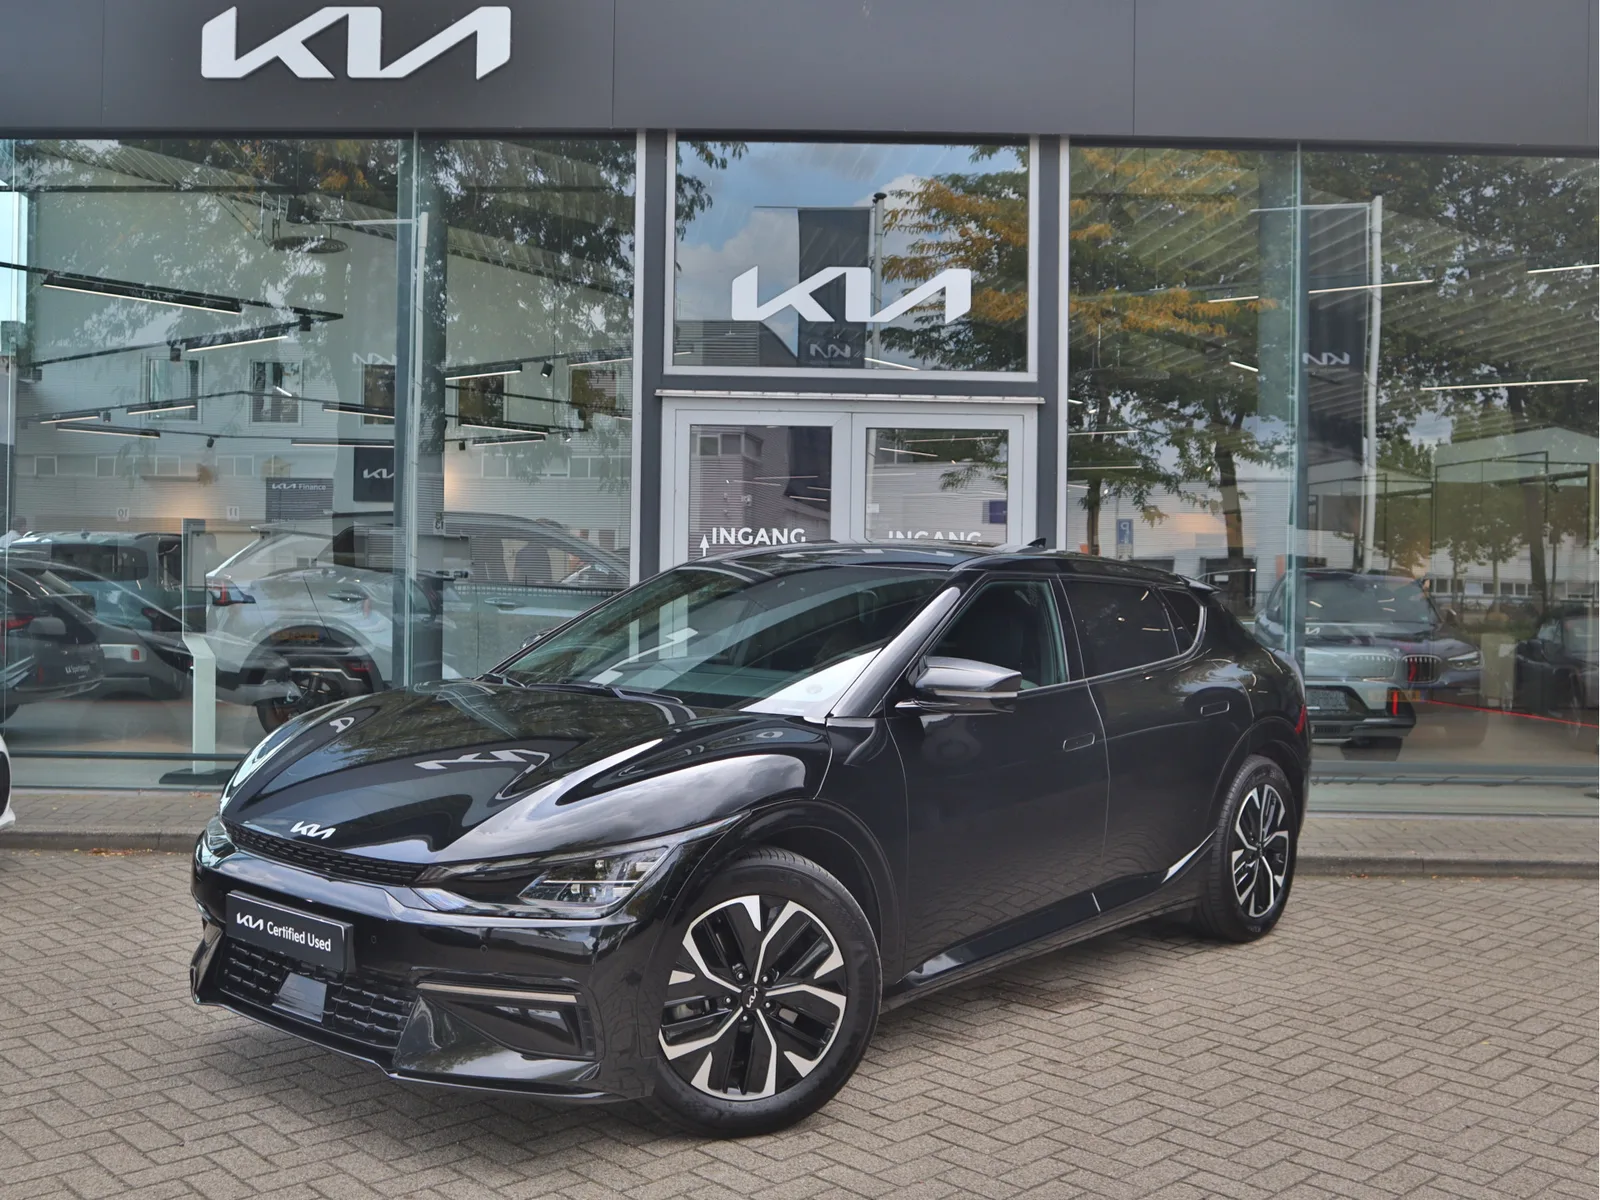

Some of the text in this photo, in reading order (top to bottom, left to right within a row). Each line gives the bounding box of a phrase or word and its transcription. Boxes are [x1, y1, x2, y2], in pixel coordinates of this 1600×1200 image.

[201, 6, 511, 80] KIA
[732, 265, 971, 324] KIA
[298, 483, 327, 491] Finance
[712, 527, 806, 545] INGANG
[290, 820, 336, 840] KIA
[236, 912, 332, 952] KIA Certified Used
